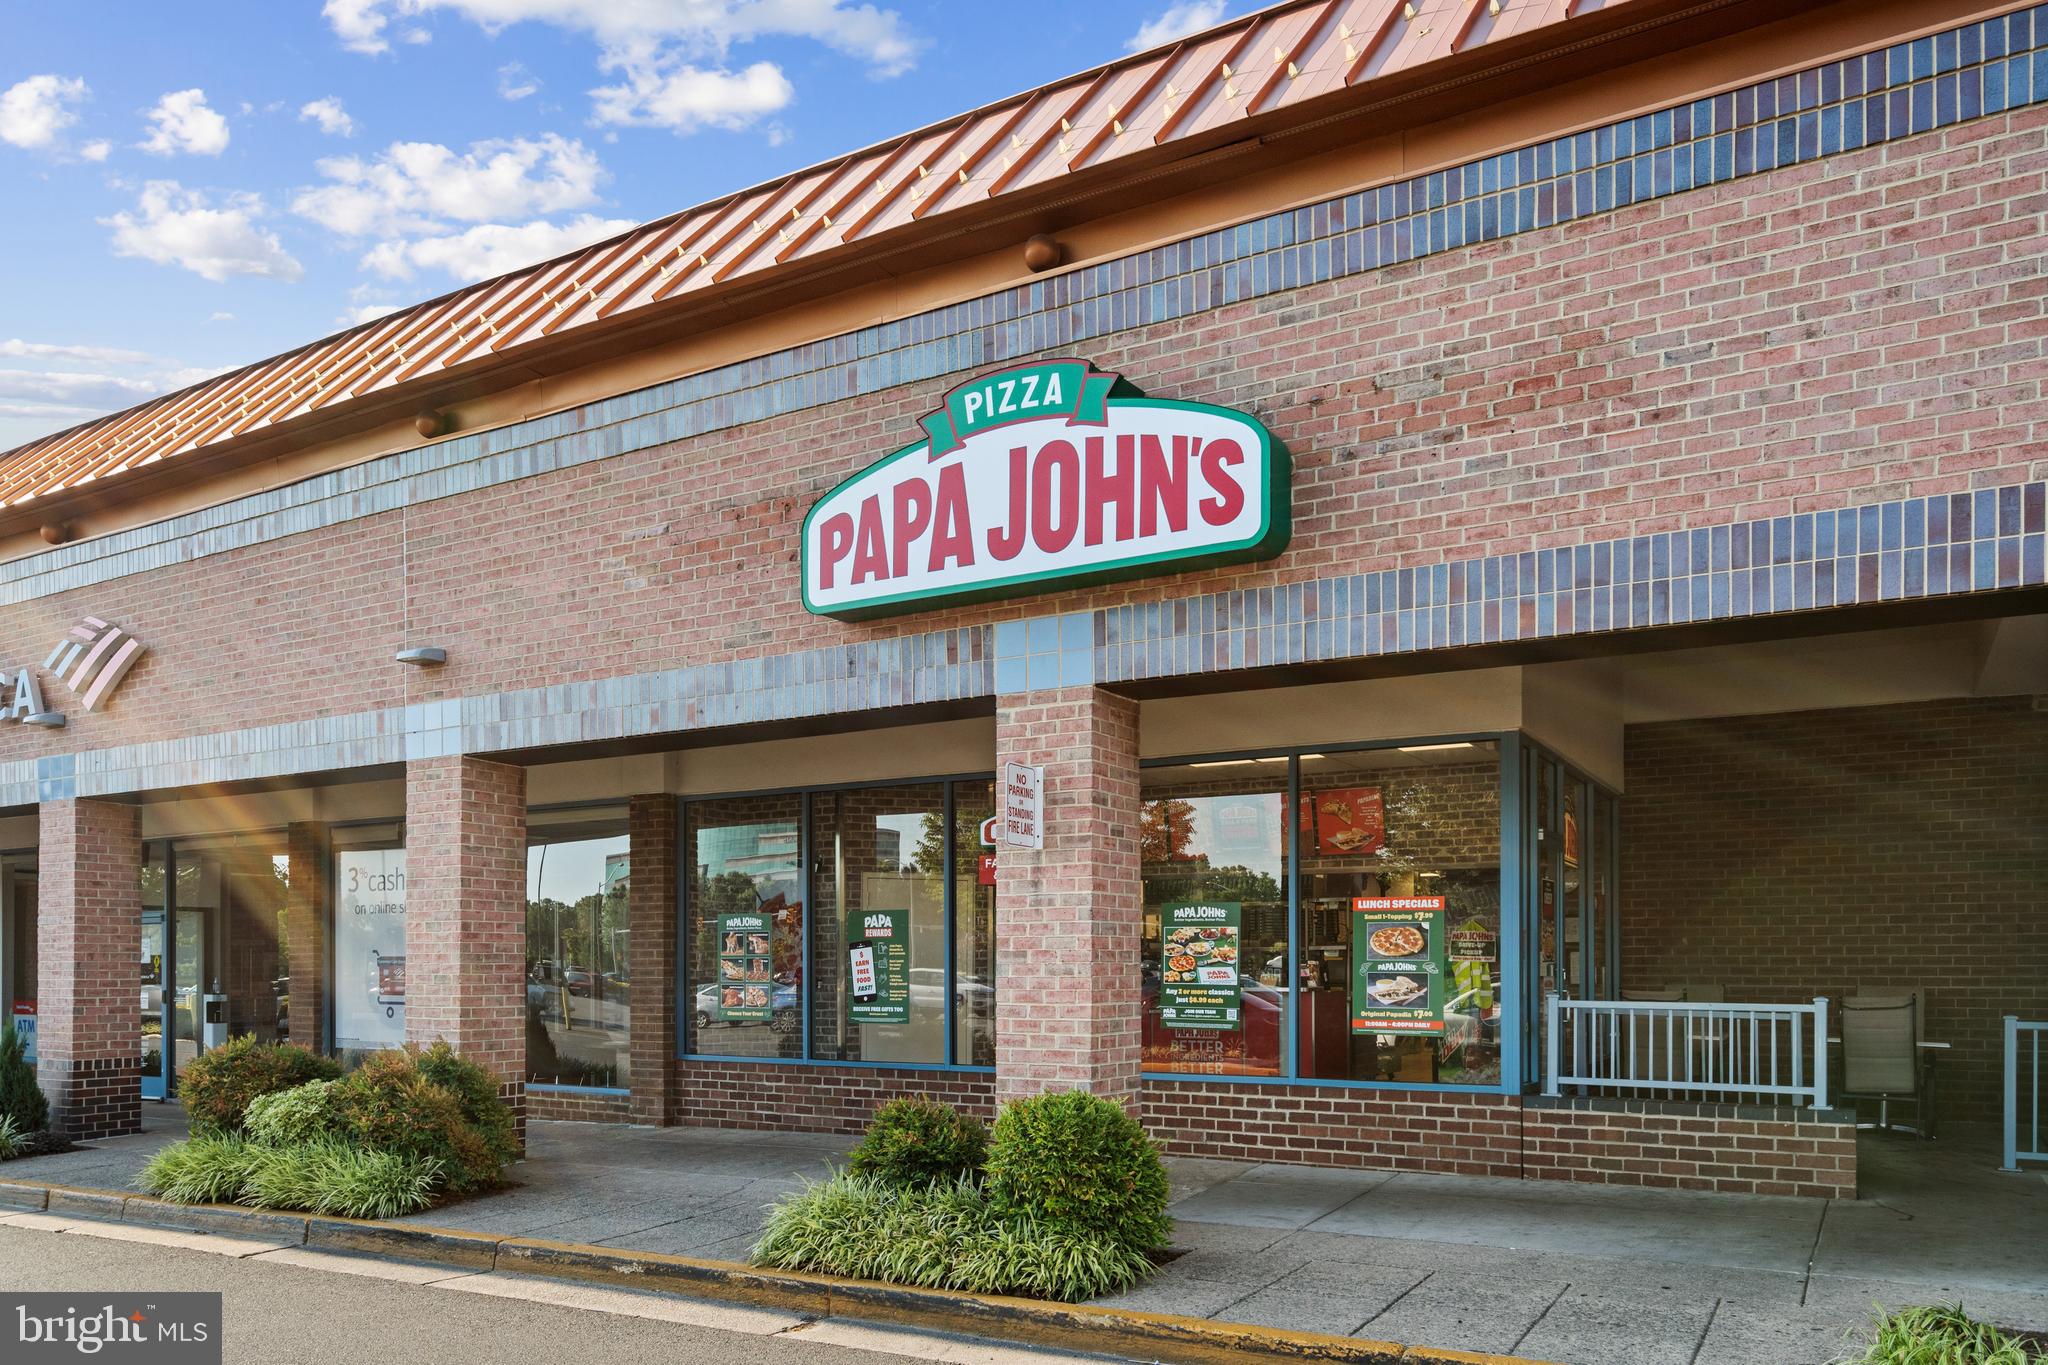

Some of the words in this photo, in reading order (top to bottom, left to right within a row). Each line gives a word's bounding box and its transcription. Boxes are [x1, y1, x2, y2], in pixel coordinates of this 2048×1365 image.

[964, 372, 1063, 425] PIZZA
[819, 461, 976, 591] PAPA
[986, 434, 1245, 562] JOHN'S
[1016, 773, 1027, 785] NO
[1008, 784, 1034, 799] PARKING
[1008, 806, 1034, 821] STANDING
[1008, 820, 1020, 834] FIRE
[1021, 822, 1034, 837] LANE
[368, 867, 405, 892] cash
[354, 904, 367, 915] on
[369, 901, 396, 914] online
[1357, 900, 1390, 909] LUNCH
[1392, 899, 1440, 908] SPECIALS
[1174, 907, 1196, 918] PAPA
[1196, 906, 1226, 918] JOHNS
[726, 917, 741, 927] PAPA
[741, 917, 763, 927] JOHNS
[864, 914, 893, 928] PAPA
[865, 928, 892, 937] REWARDS
[1394, 962, 1417, 971] JOHNS
[857, 976, 871, 984] FOOD
[1165, 988, 1178, 996] Any
[17, 1019, 35, 1033] ATM
[1170, 1040, 1224, 1053] BETTER
[1170, 1053, 1224, 1062] INGREDIENTS
[1170, 1061, 1224, 1075] BETTER
